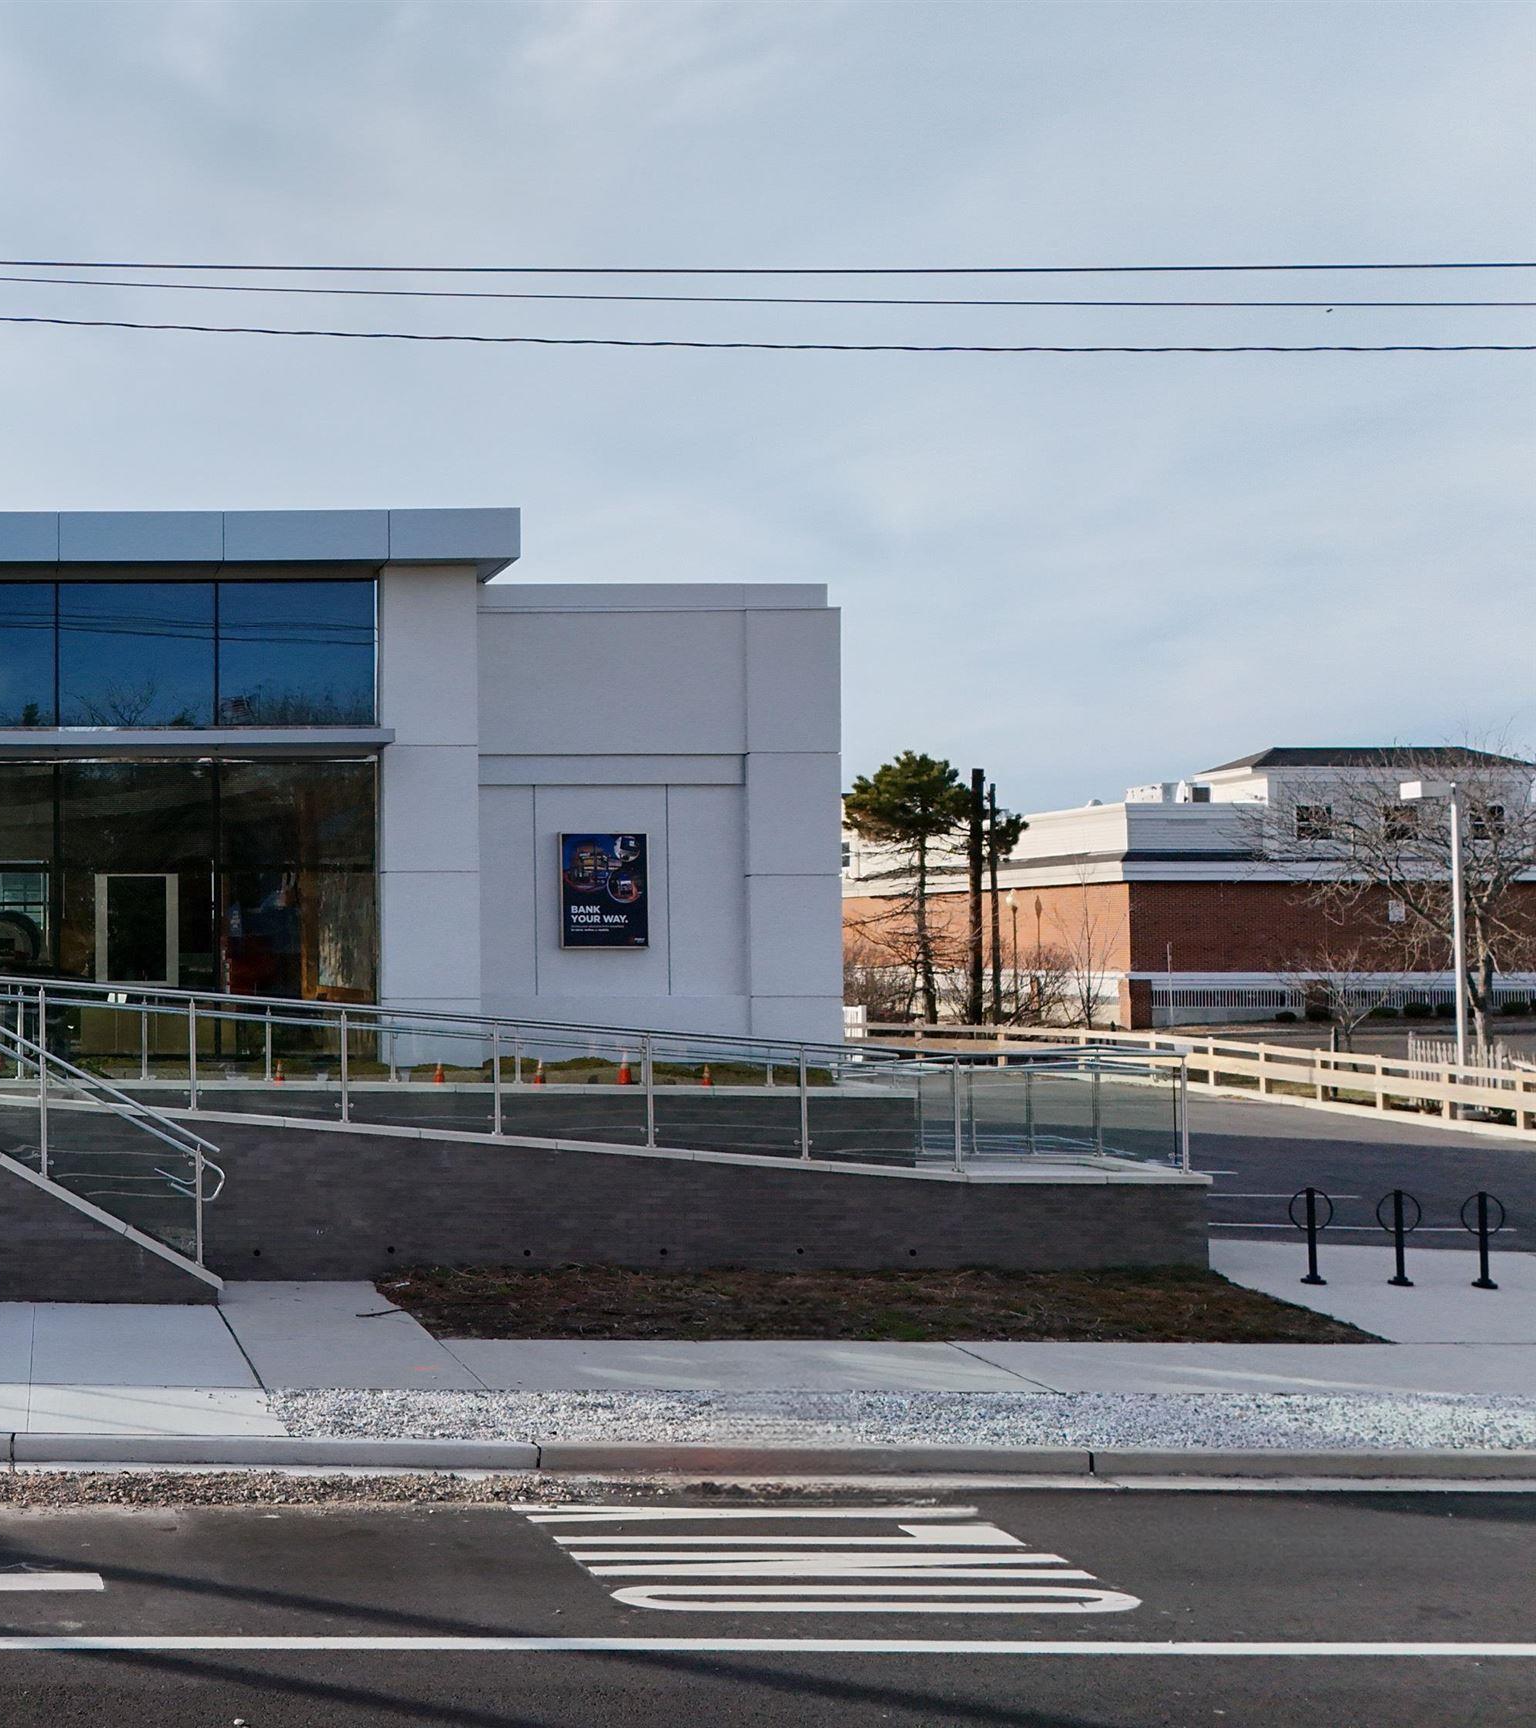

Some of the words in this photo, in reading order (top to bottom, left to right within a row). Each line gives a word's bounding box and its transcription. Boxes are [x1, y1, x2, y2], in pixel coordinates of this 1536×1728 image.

[571, 905, 601, 913] BANK
[571, 915, 601, 923] YOUR
[603, 915, 629, 923] WAY.
